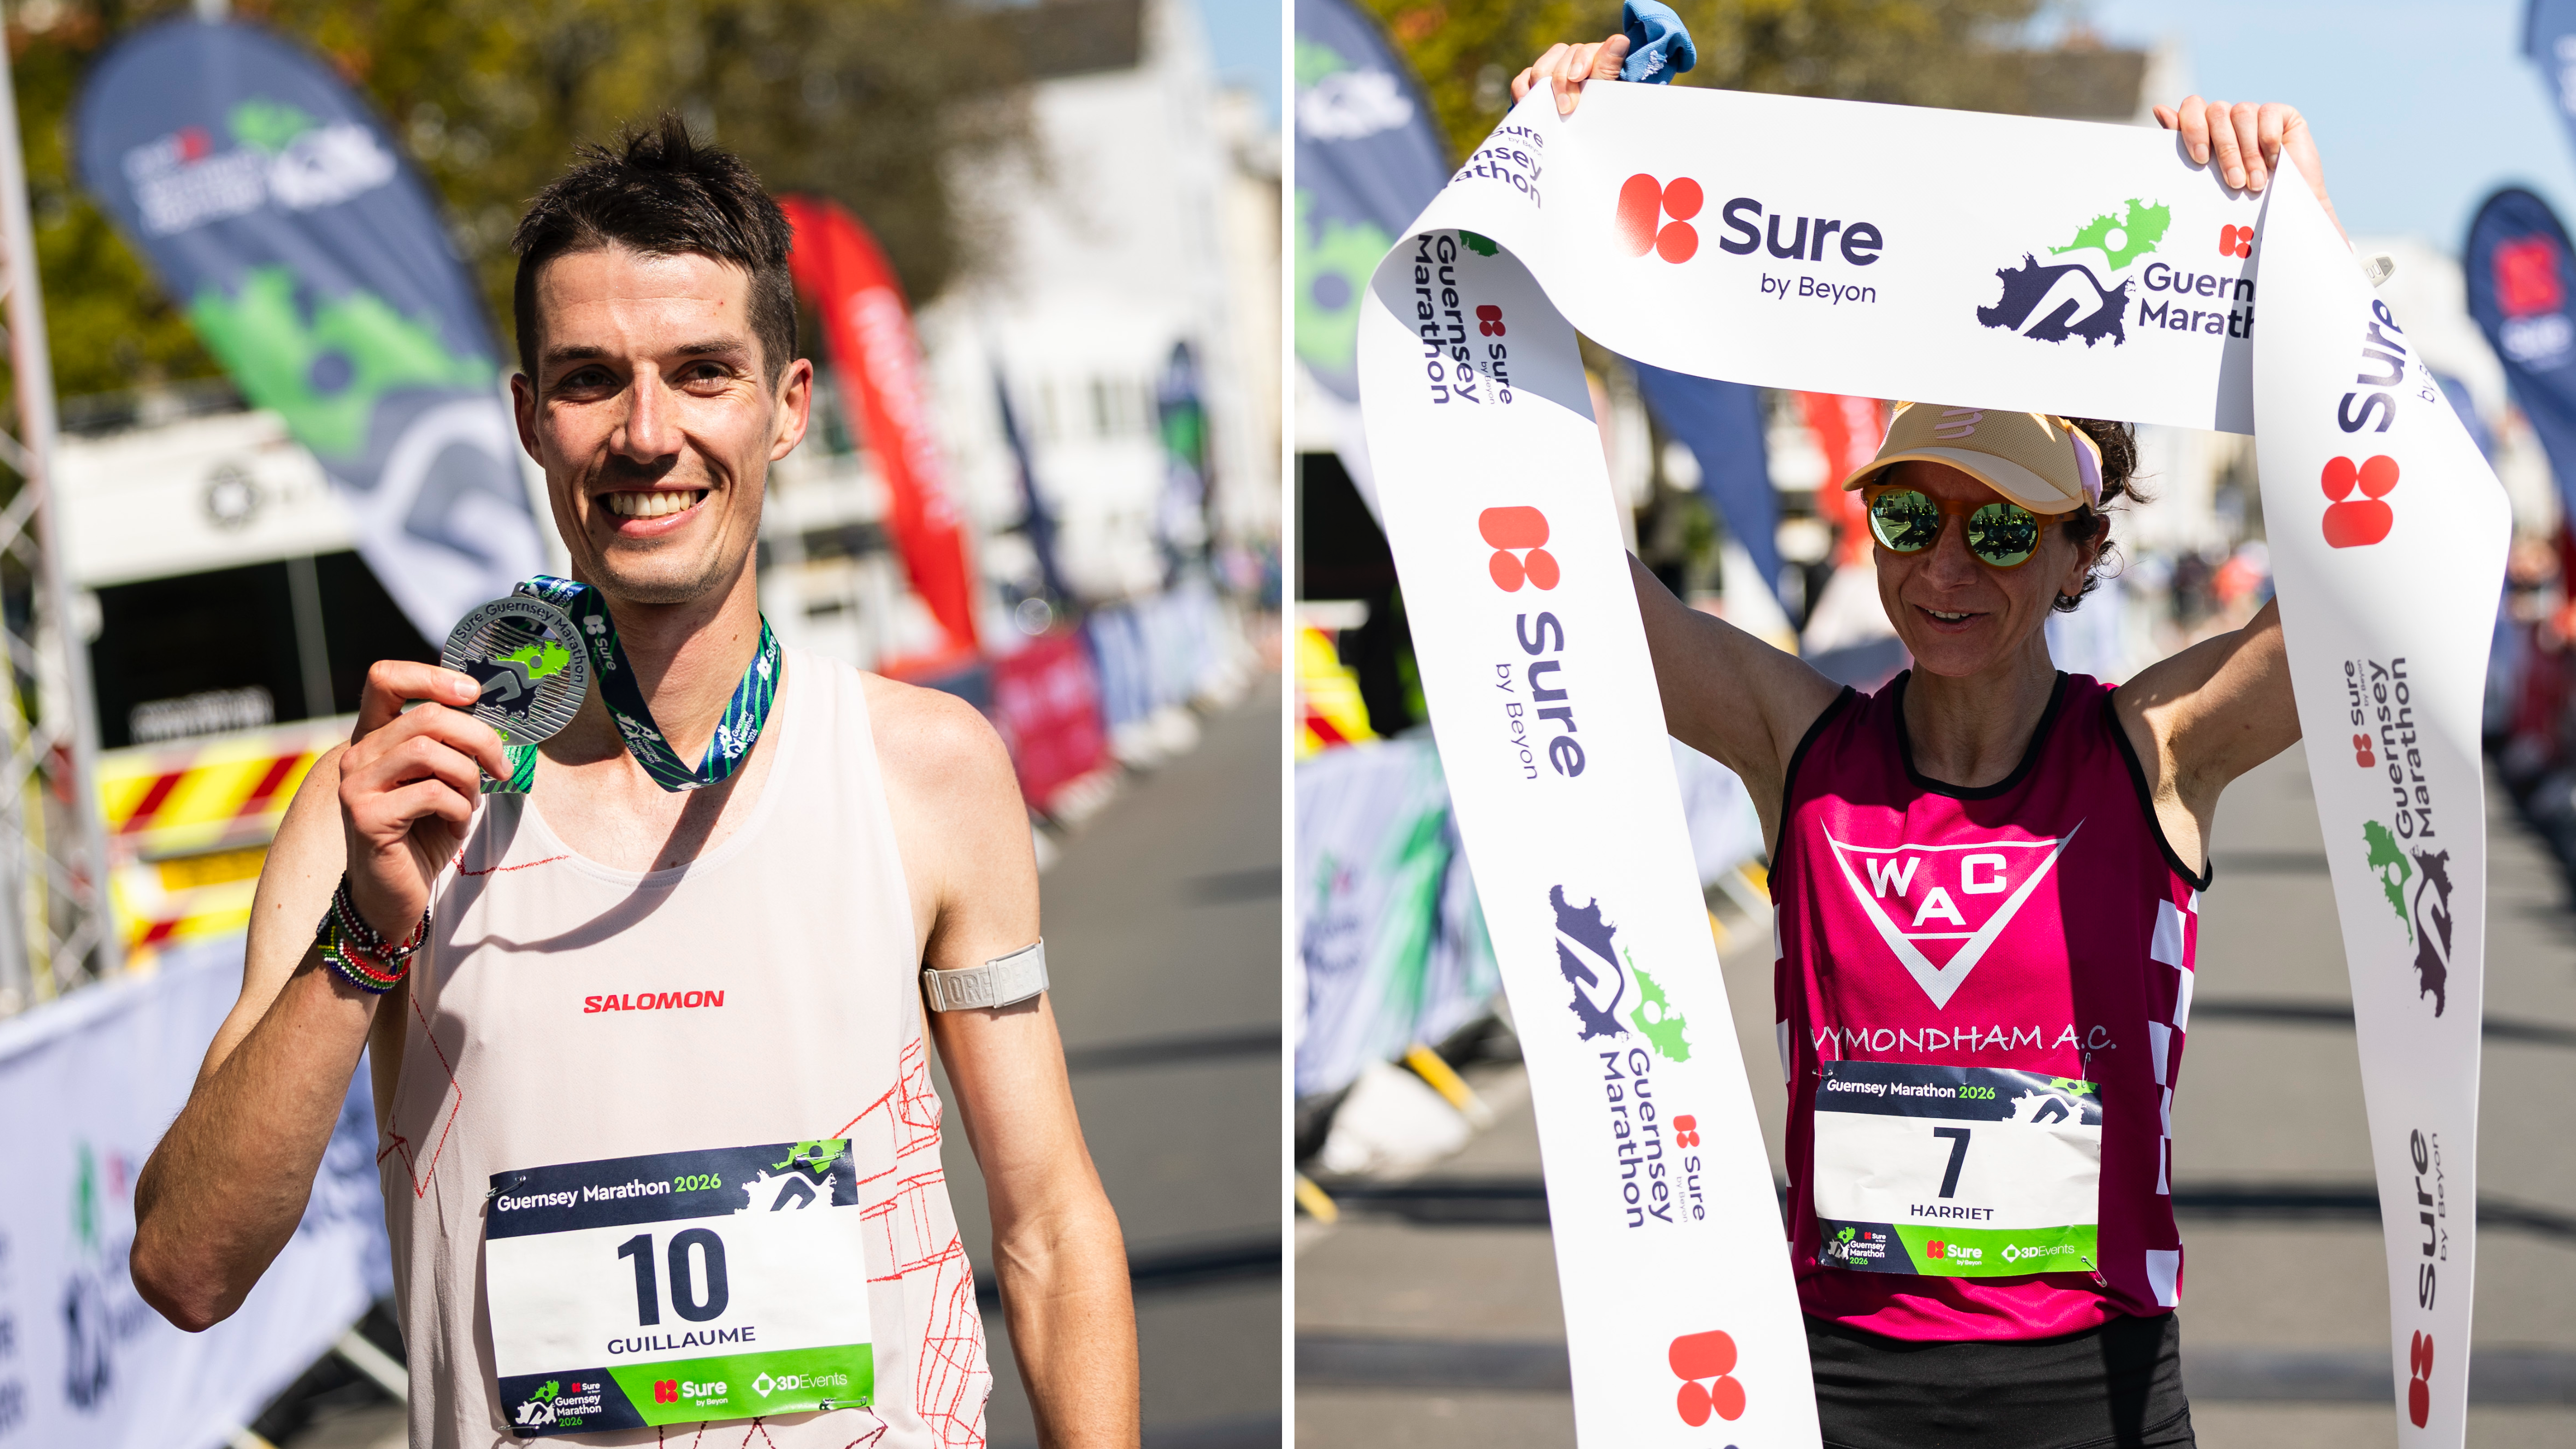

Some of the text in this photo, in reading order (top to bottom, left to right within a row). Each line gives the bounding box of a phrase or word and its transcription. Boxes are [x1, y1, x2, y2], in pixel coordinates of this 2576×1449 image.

[1490, 126, 1544, 148] Sure
[1523, 140, 1544, 160] Beyon
[1467, 147, 1542, 181] nsey
[1454, 161, 1541, 209] athon
[1719, 197, 1883, 266] Sure
[1761, 273, 1876, 305] by Beyon
[1415, 234, 1450, 404] Marathon
[1437, 235, 1480, 404] Guernsey
[1488, 343, 1512, 404] Sure
[2338, 299, 2406, 433] Sure
[1481, 361, 1495, 404] by Beyon
[456, 602, 585, 683] Sure Guernsey Marathon
[595, 638, 617, 670] Sure
[766, 635, 777, 662] Sure
[1516, 612, 1585, 777] Sure
[2344, 660, 2364, 726] Sure
[731, 709, 749, 737] Guernsey
[738, 714, 755, 740] Marathon
[747, 729, 759, 742] 2026
[1496, 664, 1537, 779] by Beyon
[626, 740, 640, 755] 2026
[634, 739, 655, 764] Marathon
[643, 737, 663, 763] Guernsey
[2368, 659, 2414, 839] Guernsey
[2391, 657, 2435, 837] Marathon
[583, 990, 724, 1014] SALOMON
[2052, 1024, 2117, 1049] A.C.
[1827, 1079, 1996, 1100] Guernsey Marathon 2026
[1600, 1051, 1644, 1228] Marathon
[1628, 1047, 1673, 1224] Guernsey
[1933, 1127, 1971, 1199] 7
[497, 1173, 722, 1212] Guernsey Marathon 2026
[1676, 1177, 1688, 1222] by Beyon
[1685, 1156, 1705, 1221] Sure
[2432, 1133, 2448, 1261] by Beyon
[1911, 1204, 1994, 1221] HARRIET
[2410, 1128, 2435, 1311] Sure
[1850, 1240, 1885, 1251] Guernsey
[1850, 1248, 1885, 1258] Marathon
[1947, 1244, 1982, 1258] Sure
[2021, 1244, 2075, 1258] 3DEvents
[617, 1227, 729, 1326] 10
[607, 1326, 756, 1355] GUILLAUME
[682, 1381, 727, 1397] Sure
[776, 1371, 848, 1391] 3DEvents
[555, 1395, 601, 1406] Guernsey
[557, 1404, 601, 1416] Marathon
[706, 1397, 728, 1406] Beyon
[559, 1416, 582, 1427] 2026
